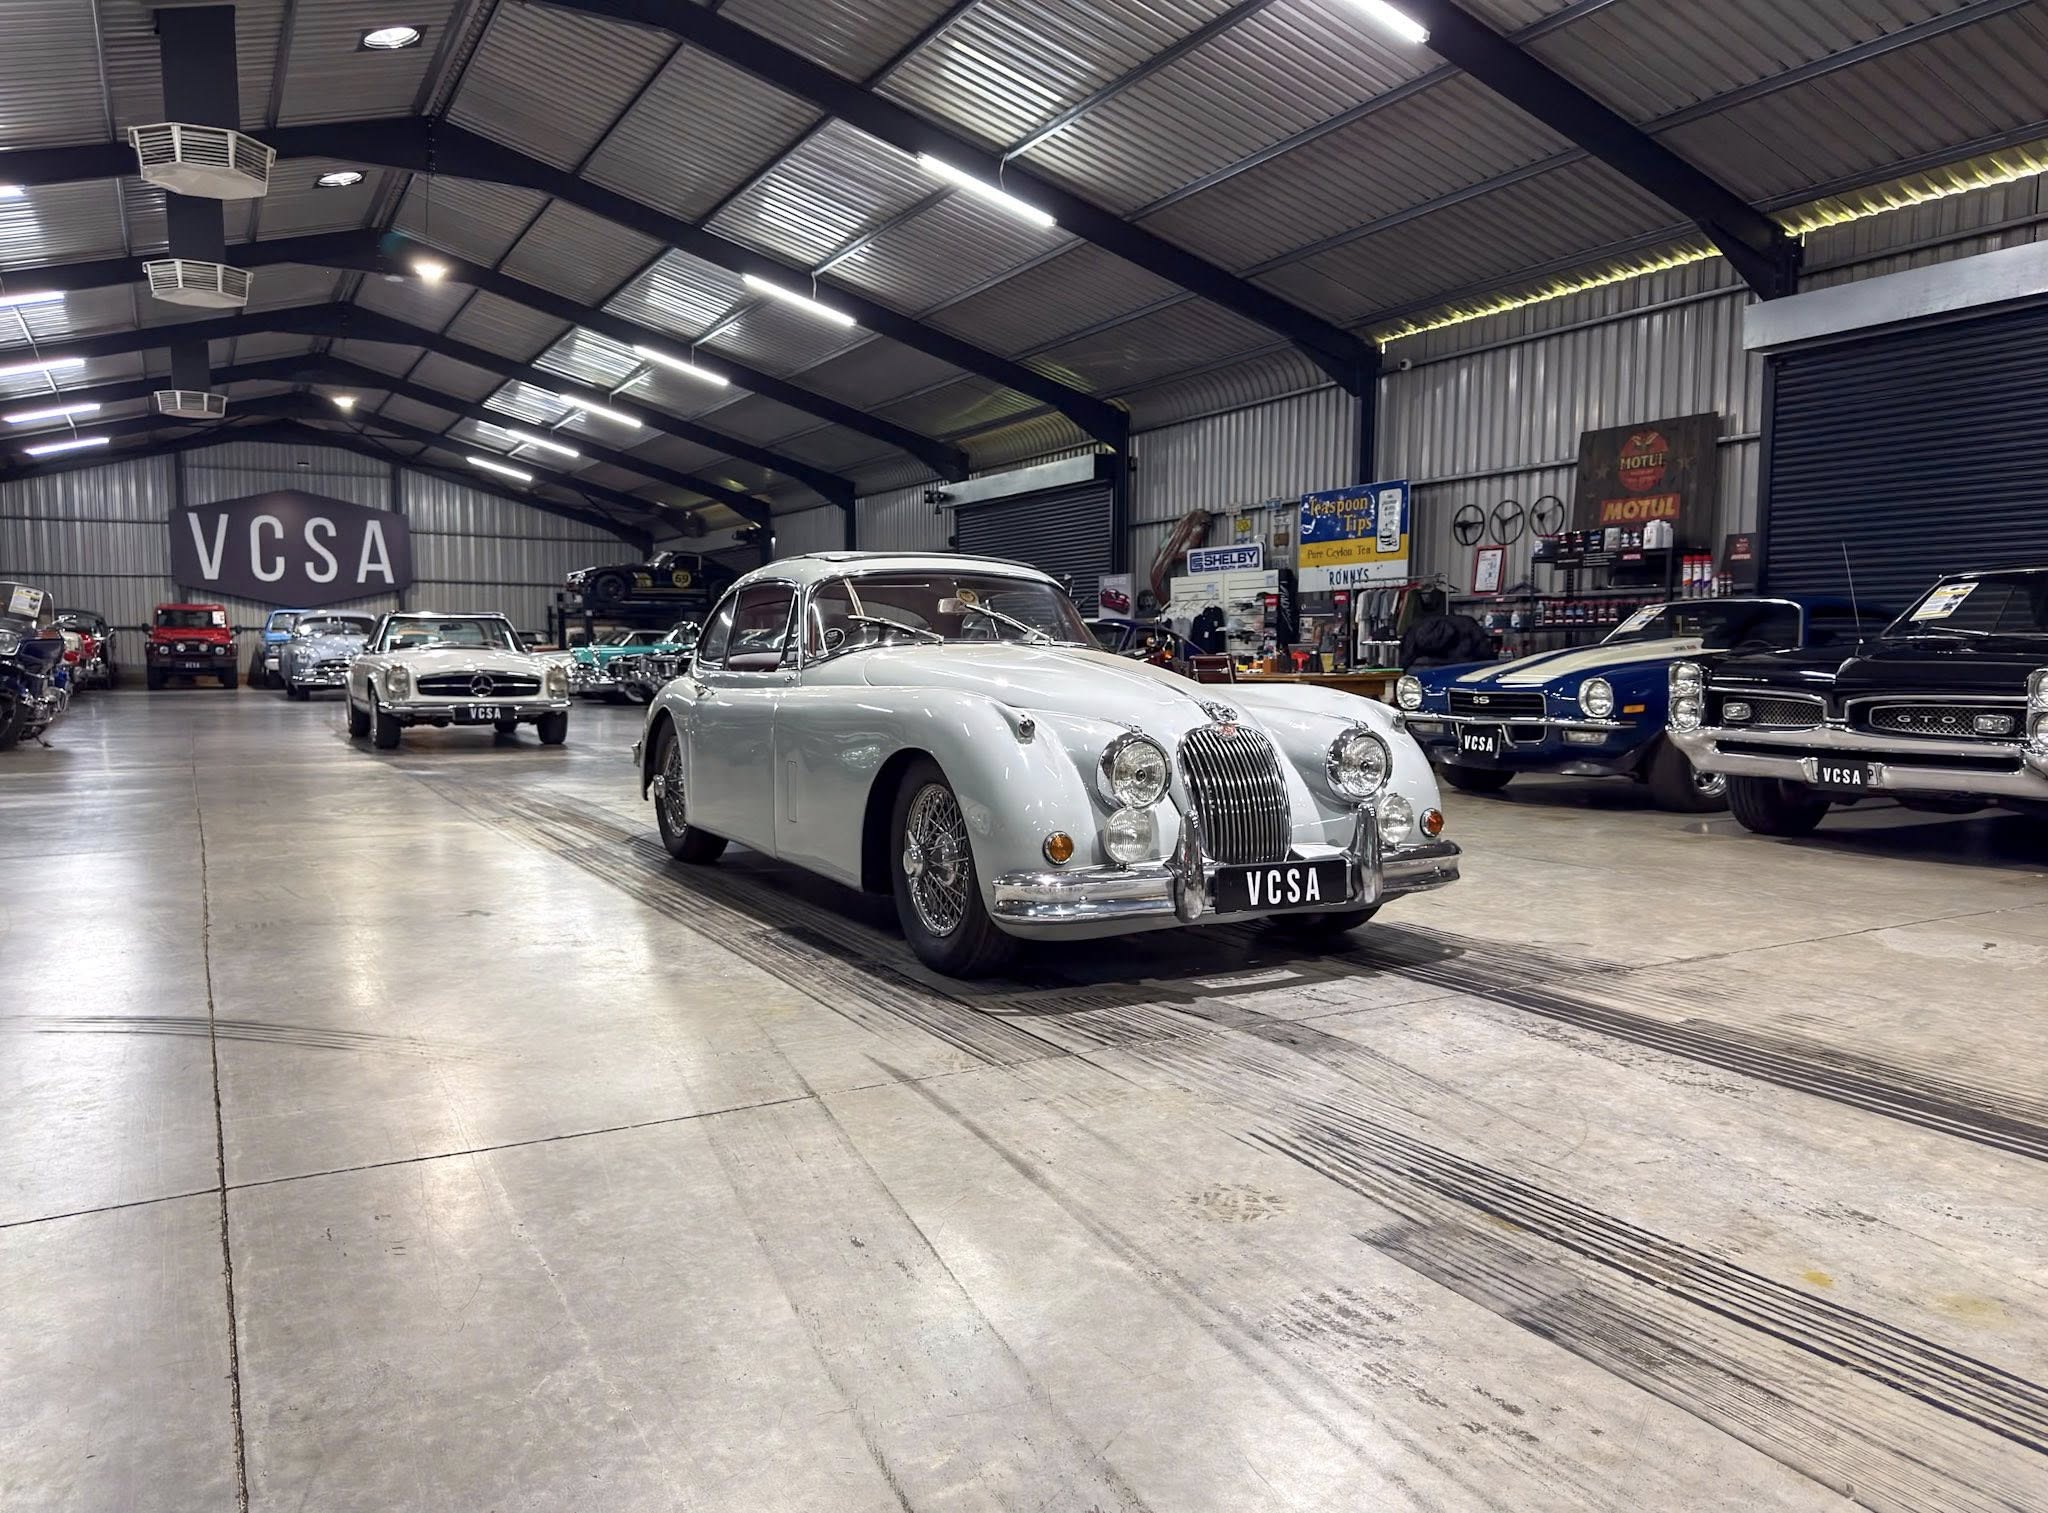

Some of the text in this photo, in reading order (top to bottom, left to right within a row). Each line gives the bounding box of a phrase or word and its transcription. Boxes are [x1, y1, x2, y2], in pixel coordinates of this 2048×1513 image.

[1308, 495, 1369, 518] Teaspoon
[1603, 497, 1676, 521] MOTUL
[1343, 513, 1372, 537] Tips
[187, 512, 396, 585] VCSA
[1307, 545, 1371, 560] Pure Ceylon Tea
[1203, 551, 1257, 567] SHELBY
[1472, 695, 1490, 704] SS
[470, 707, 501, 719] VCSA
[1896, 714, 1957, 724] GTO
[1464, 734, 1493, 752] VCSA
[1822, 766, 1861, 785] VCSA
[1246, 867, 1321, 906] VCSA
